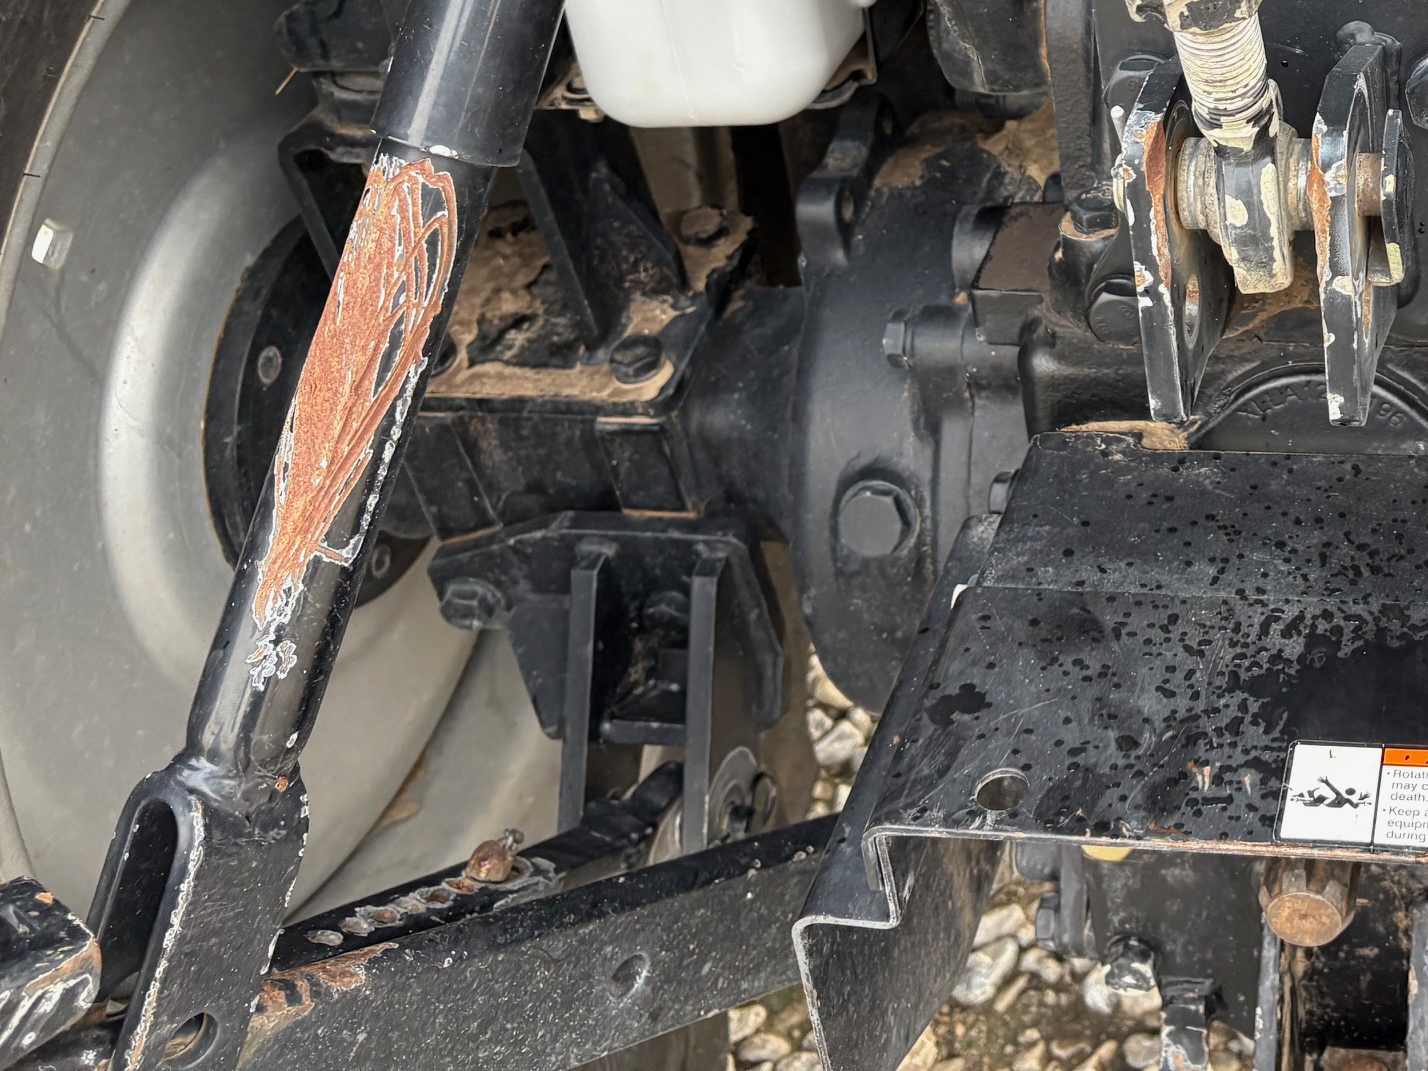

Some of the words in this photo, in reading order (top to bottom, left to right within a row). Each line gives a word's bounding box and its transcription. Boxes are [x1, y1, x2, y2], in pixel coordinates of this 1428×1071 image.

[1391, 782, 1418, 792] may
[1390, 791, 1428, 802] death.
[1388, 805, 1421, 818] Keep
[1386, 830, 1426, 843] during
